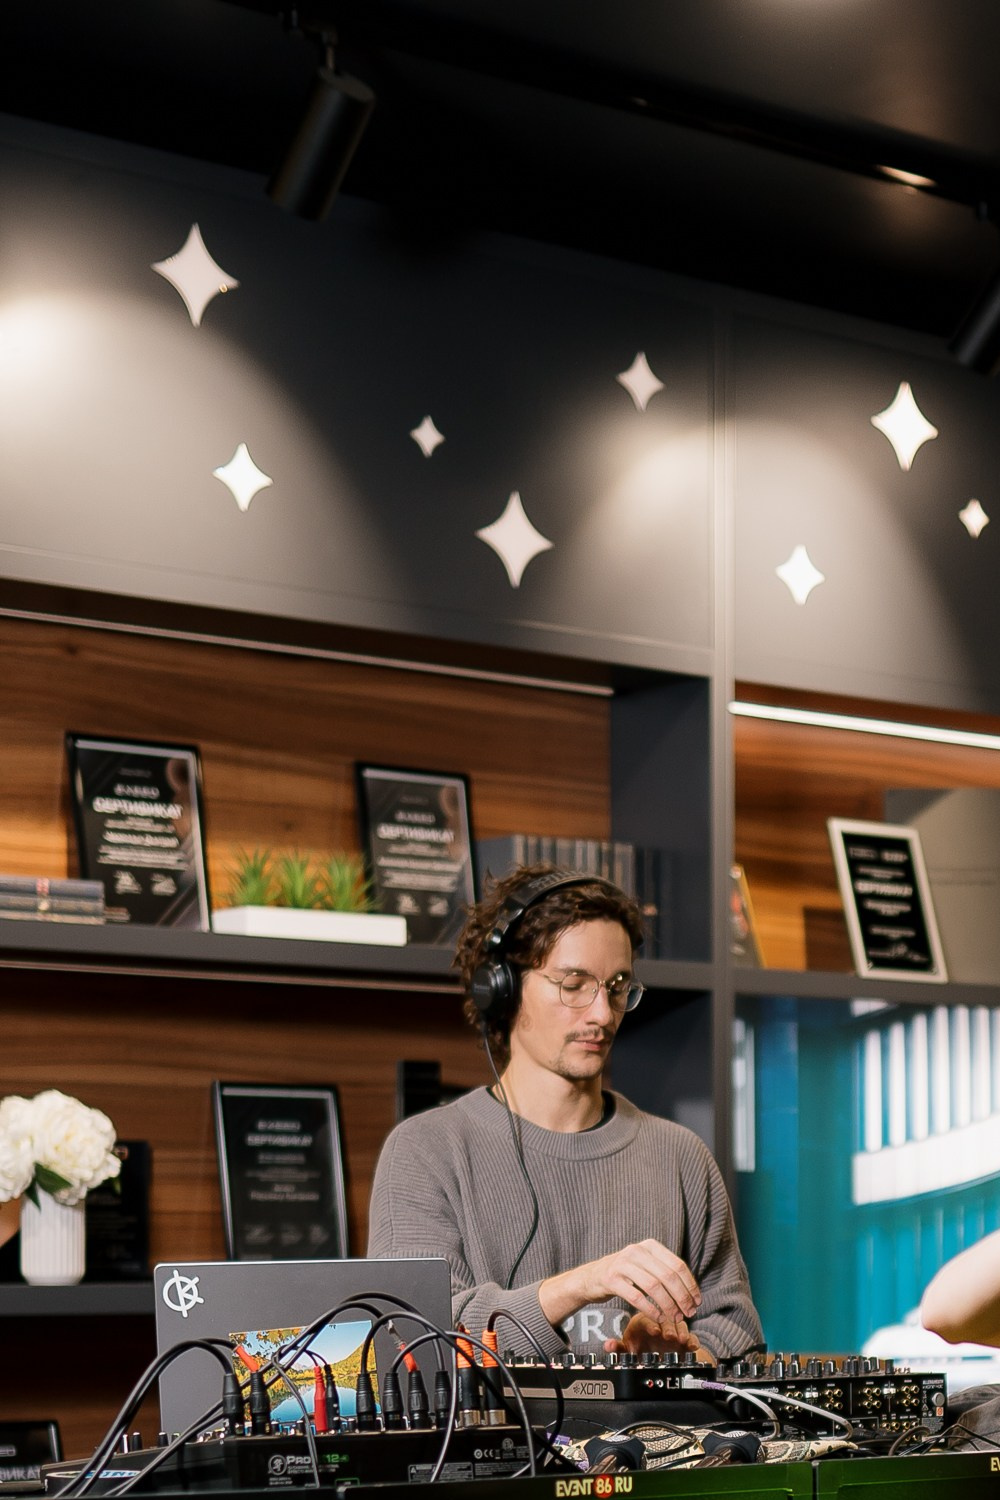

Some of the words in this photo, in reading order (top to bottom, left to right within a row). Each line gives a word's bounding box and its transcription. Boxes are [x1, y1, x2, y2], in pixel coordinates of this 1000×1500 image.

[555, 1479, 594, 1497] EVENT
[595, 1478, 612, 1494] 86
[614, 1476, 633, 1493] RU
